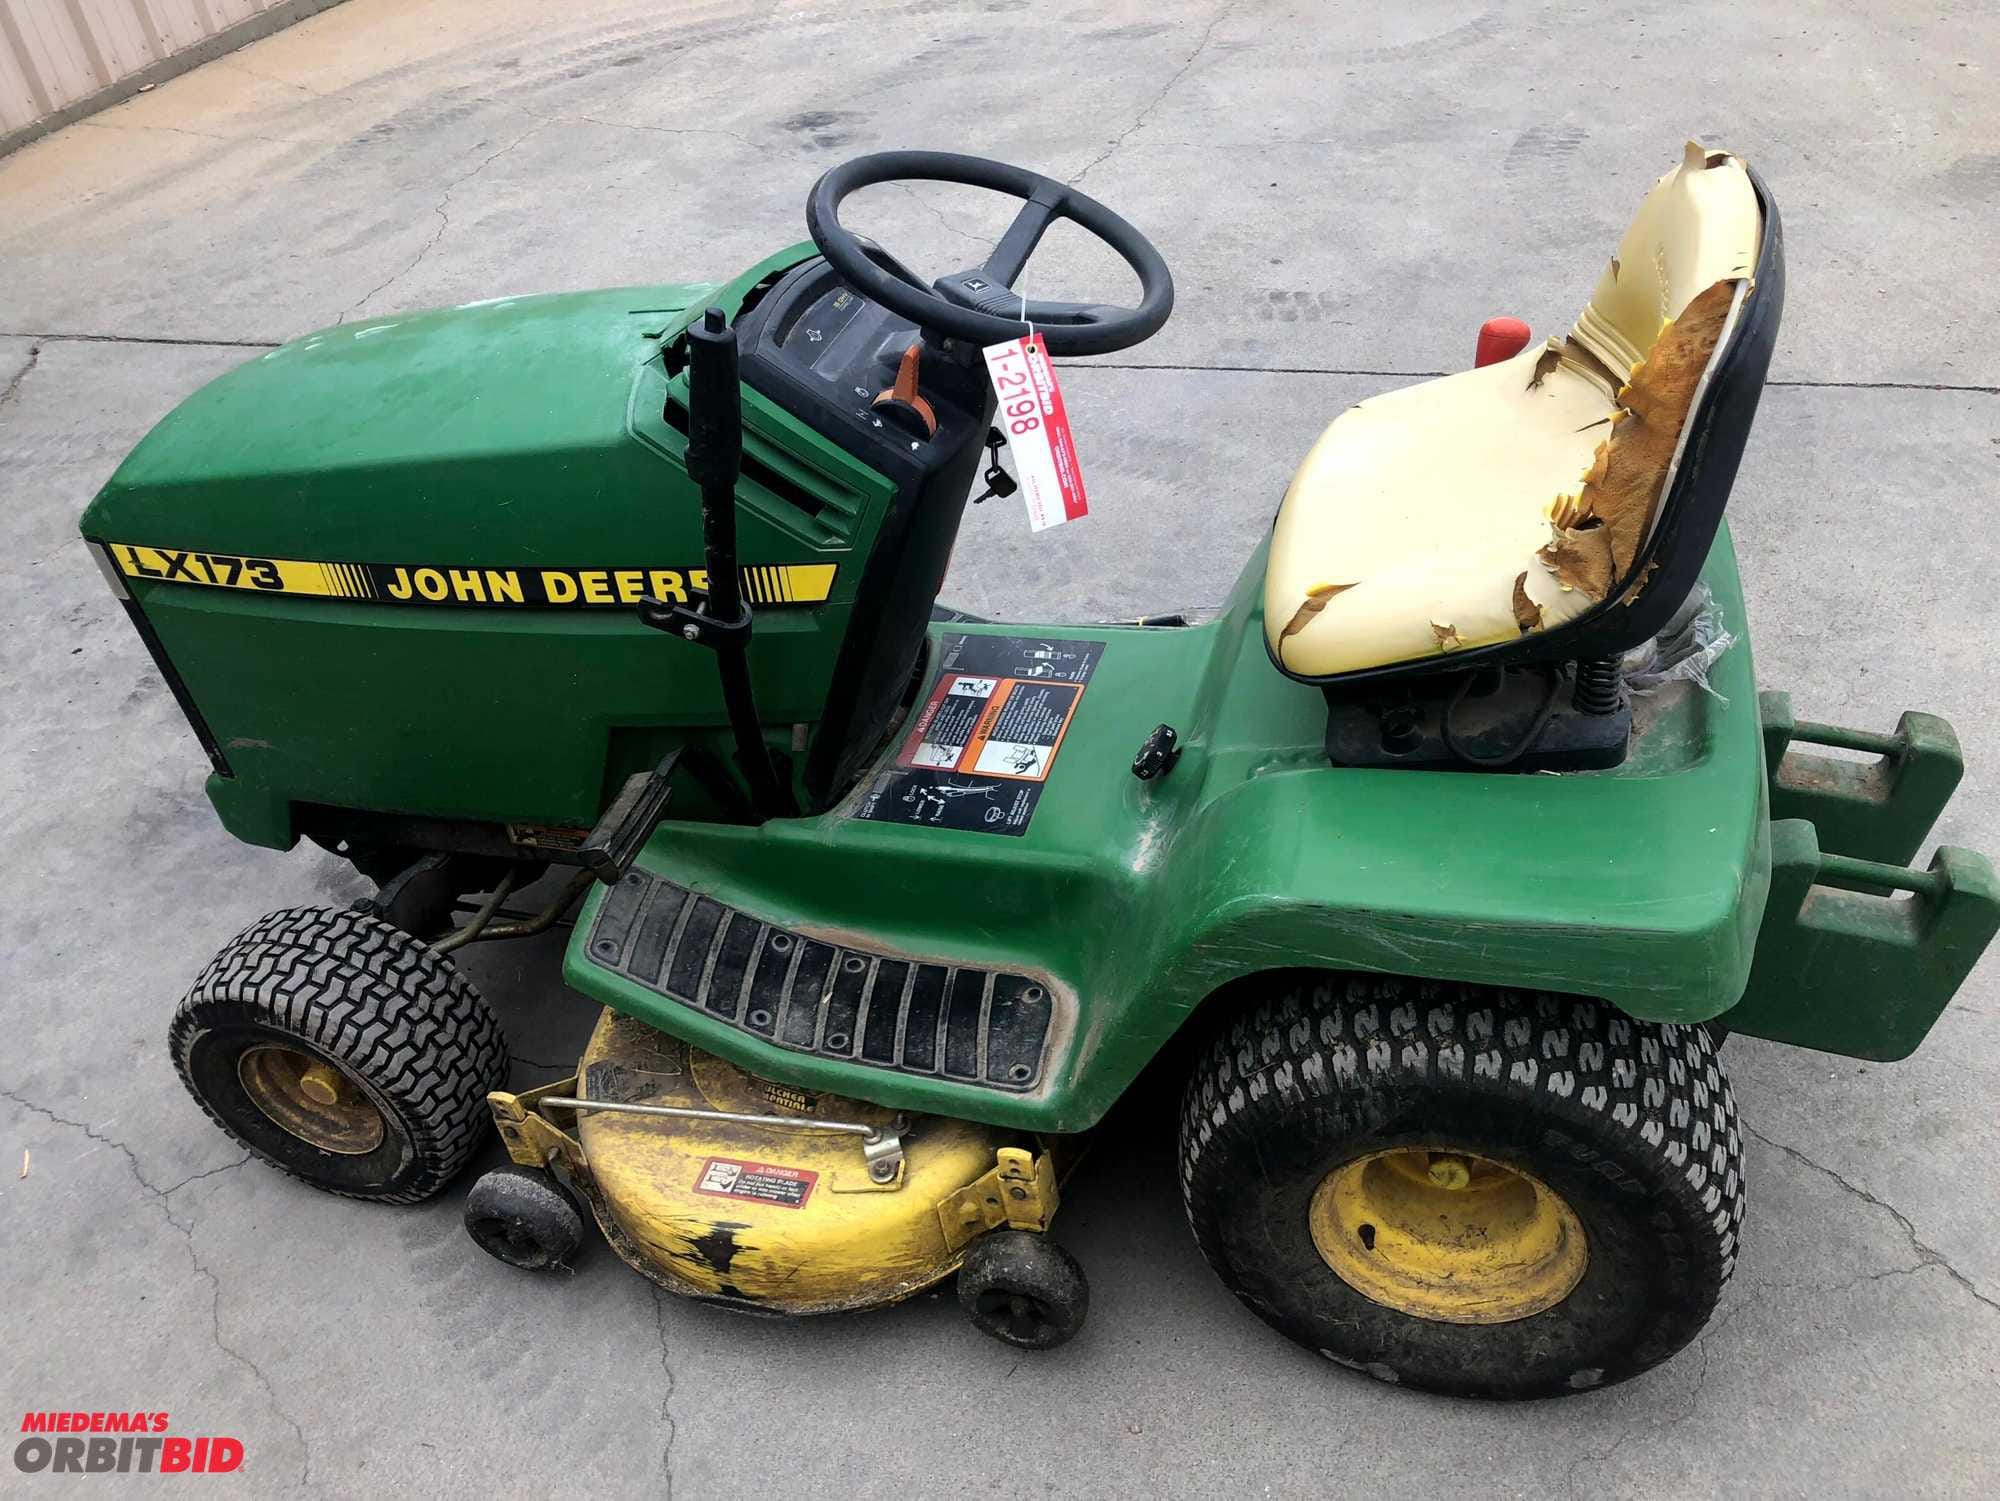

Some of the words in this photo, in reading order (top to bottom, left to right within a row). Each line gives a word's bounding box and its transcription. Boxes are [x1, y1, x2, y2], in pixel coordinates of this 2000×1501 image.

[991, 348, 1039, 435] 1-2198
[126, 547, 284, 590] LX173
[387, 567, 524, 603] JOHN
[920, 701, 940, 728] DANGER
[979, 706, 999, 737] WARNING
[765, 1168, 799, 1178] DANGER
